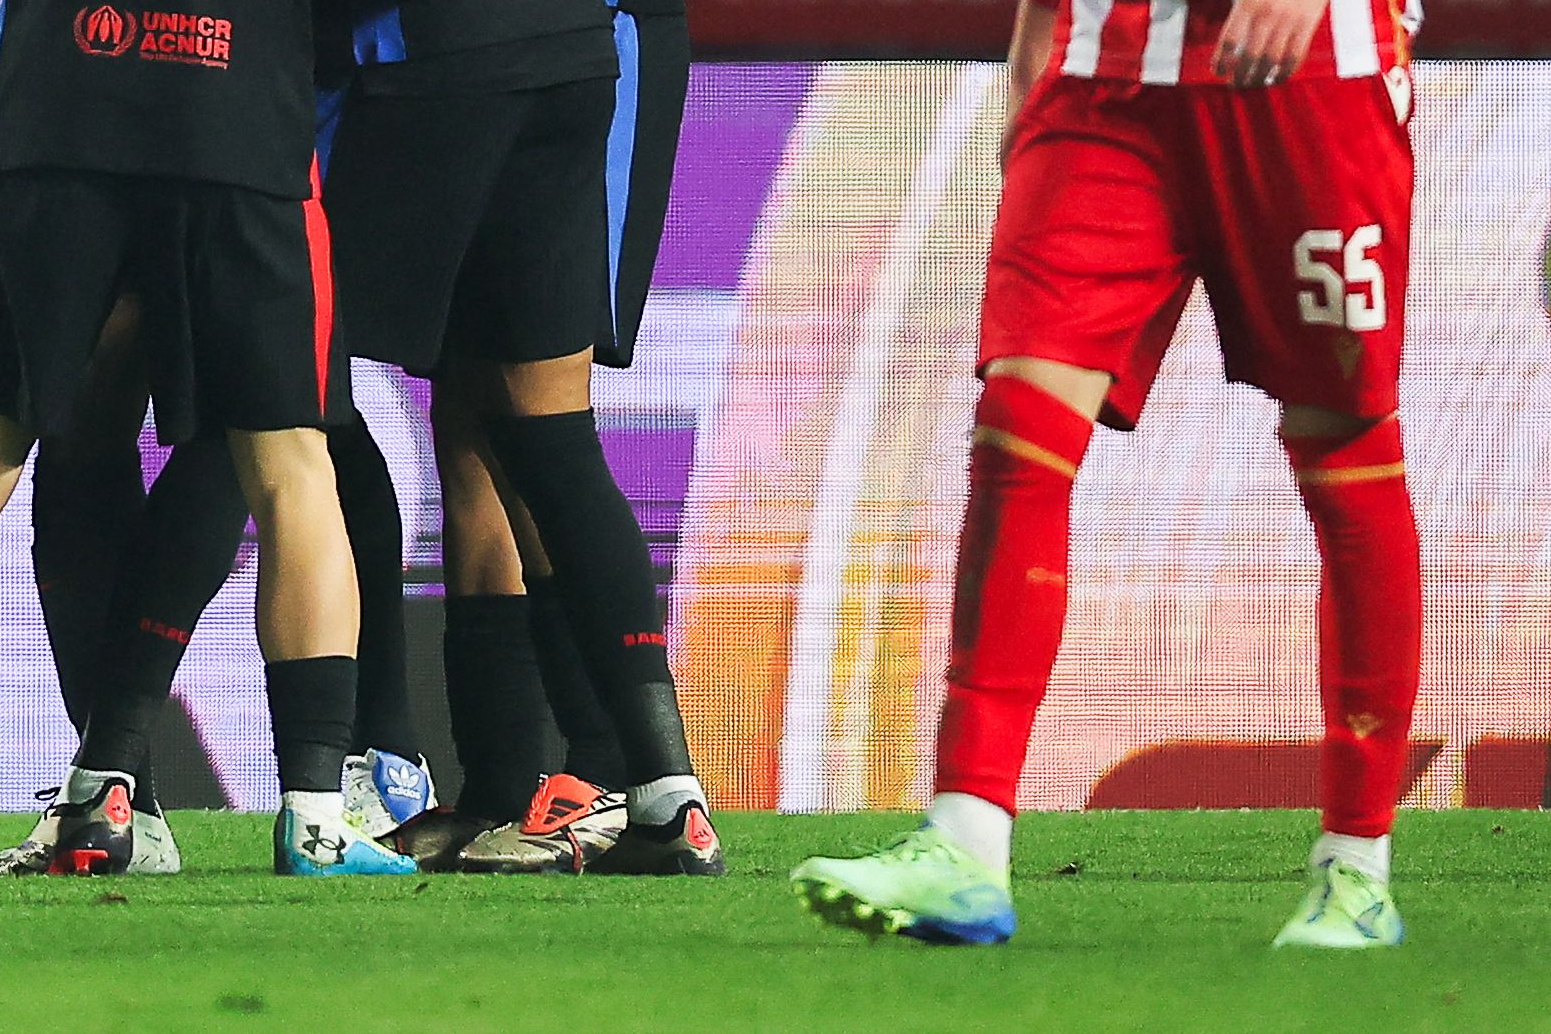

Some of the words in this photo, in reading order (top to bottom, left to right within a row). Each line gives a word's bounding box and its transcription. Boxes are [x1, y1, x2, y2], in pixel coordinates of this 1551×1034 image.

[141, 10, 232, 41] UNHCR
[139, 31, 230, 61] ACNUR
[1293, 224, 1388, 333] 55
[387, 785, 423, 801] adidas
